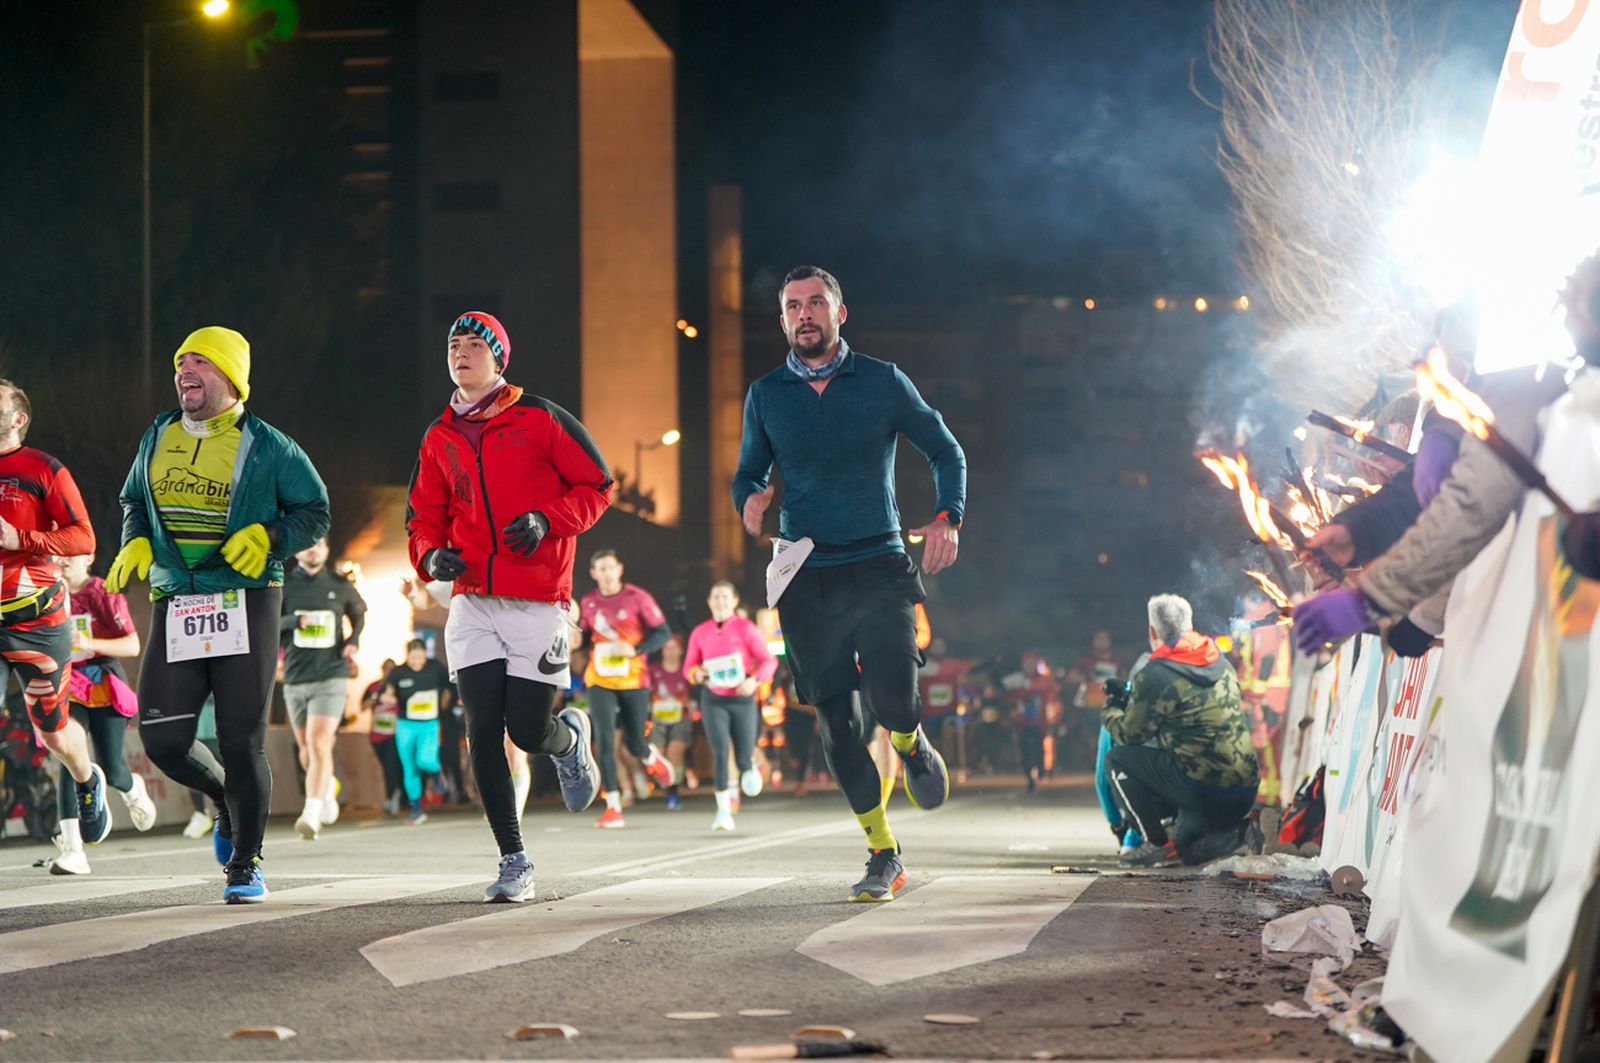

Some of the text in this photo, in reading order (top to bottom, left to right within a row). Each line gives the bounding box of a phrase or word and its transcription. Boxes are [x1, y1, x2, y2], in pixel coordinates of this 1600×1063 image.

[449, 316, 503, 357] NING
[183, 598, 205, 607] NOCHE
[206, 596, 215, 604] DE
[175, 608, 190, 617] SAN
[184, 612, 229, 636] 6718
